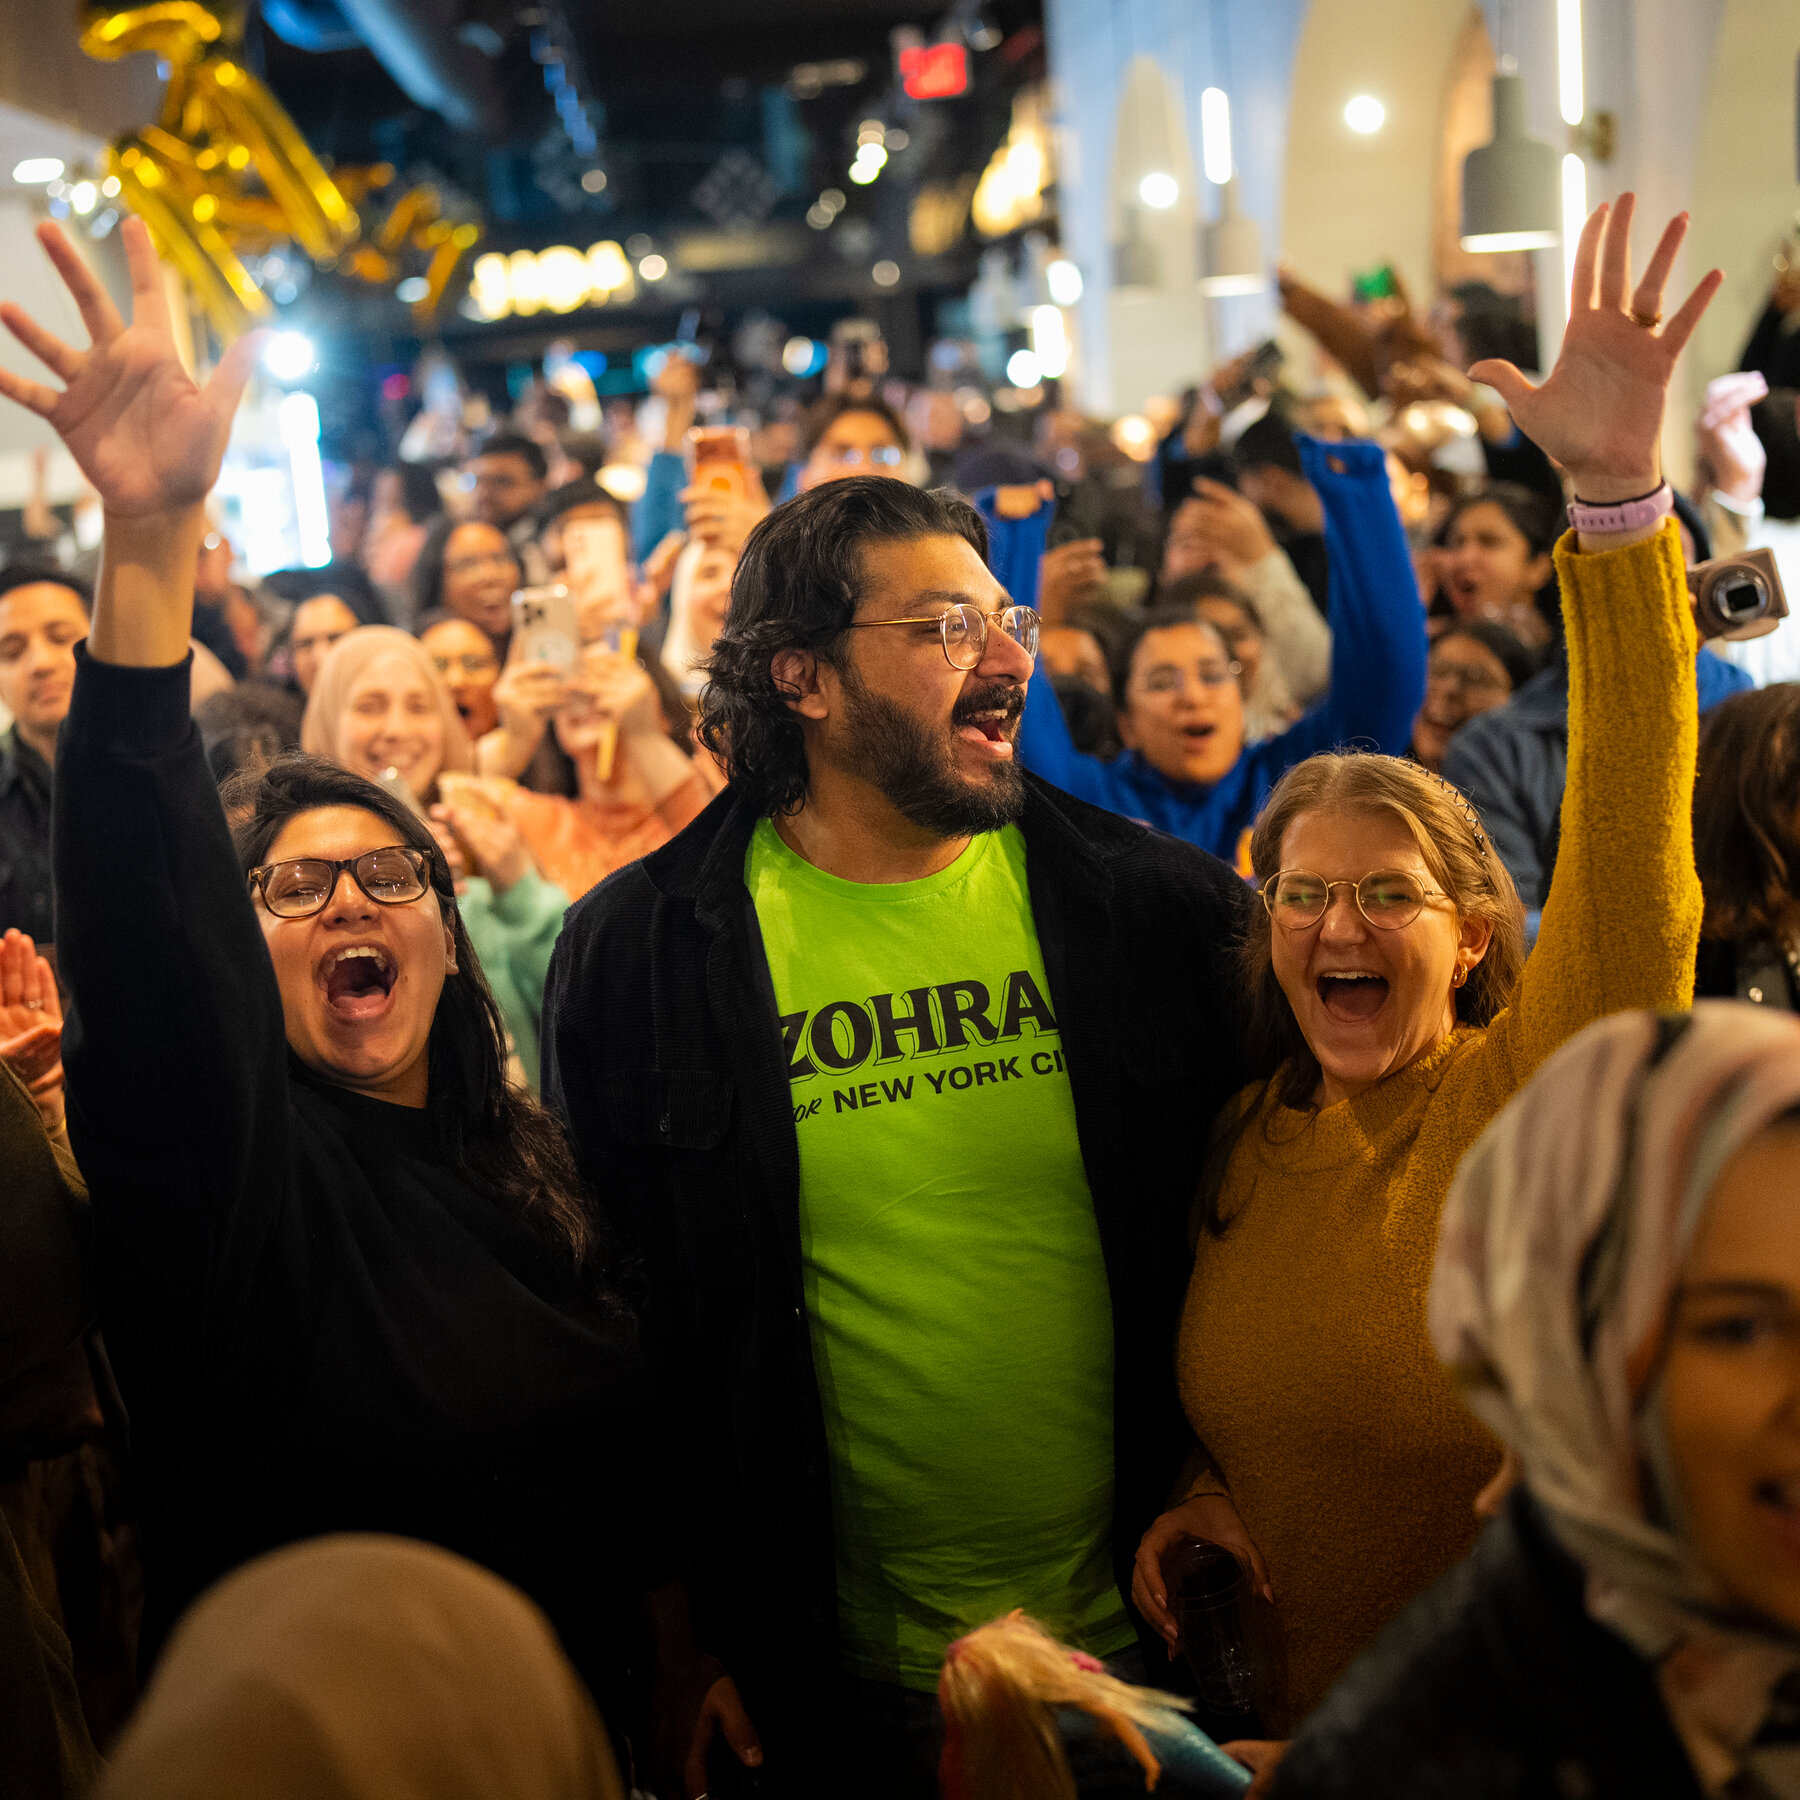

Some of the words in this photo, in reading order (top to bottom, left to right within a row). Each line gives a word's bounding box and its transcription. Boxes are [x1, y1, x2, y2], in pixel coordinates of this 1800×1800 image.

[779, 969, 1060, 1086] ZOHRA
[792, 1097, 823, 1123] OR
[833, 1075, 914, 1113] NEW
[924, 1055, 1023, 1095] YORK
[1030, 1049, 1066, 1076] CI
